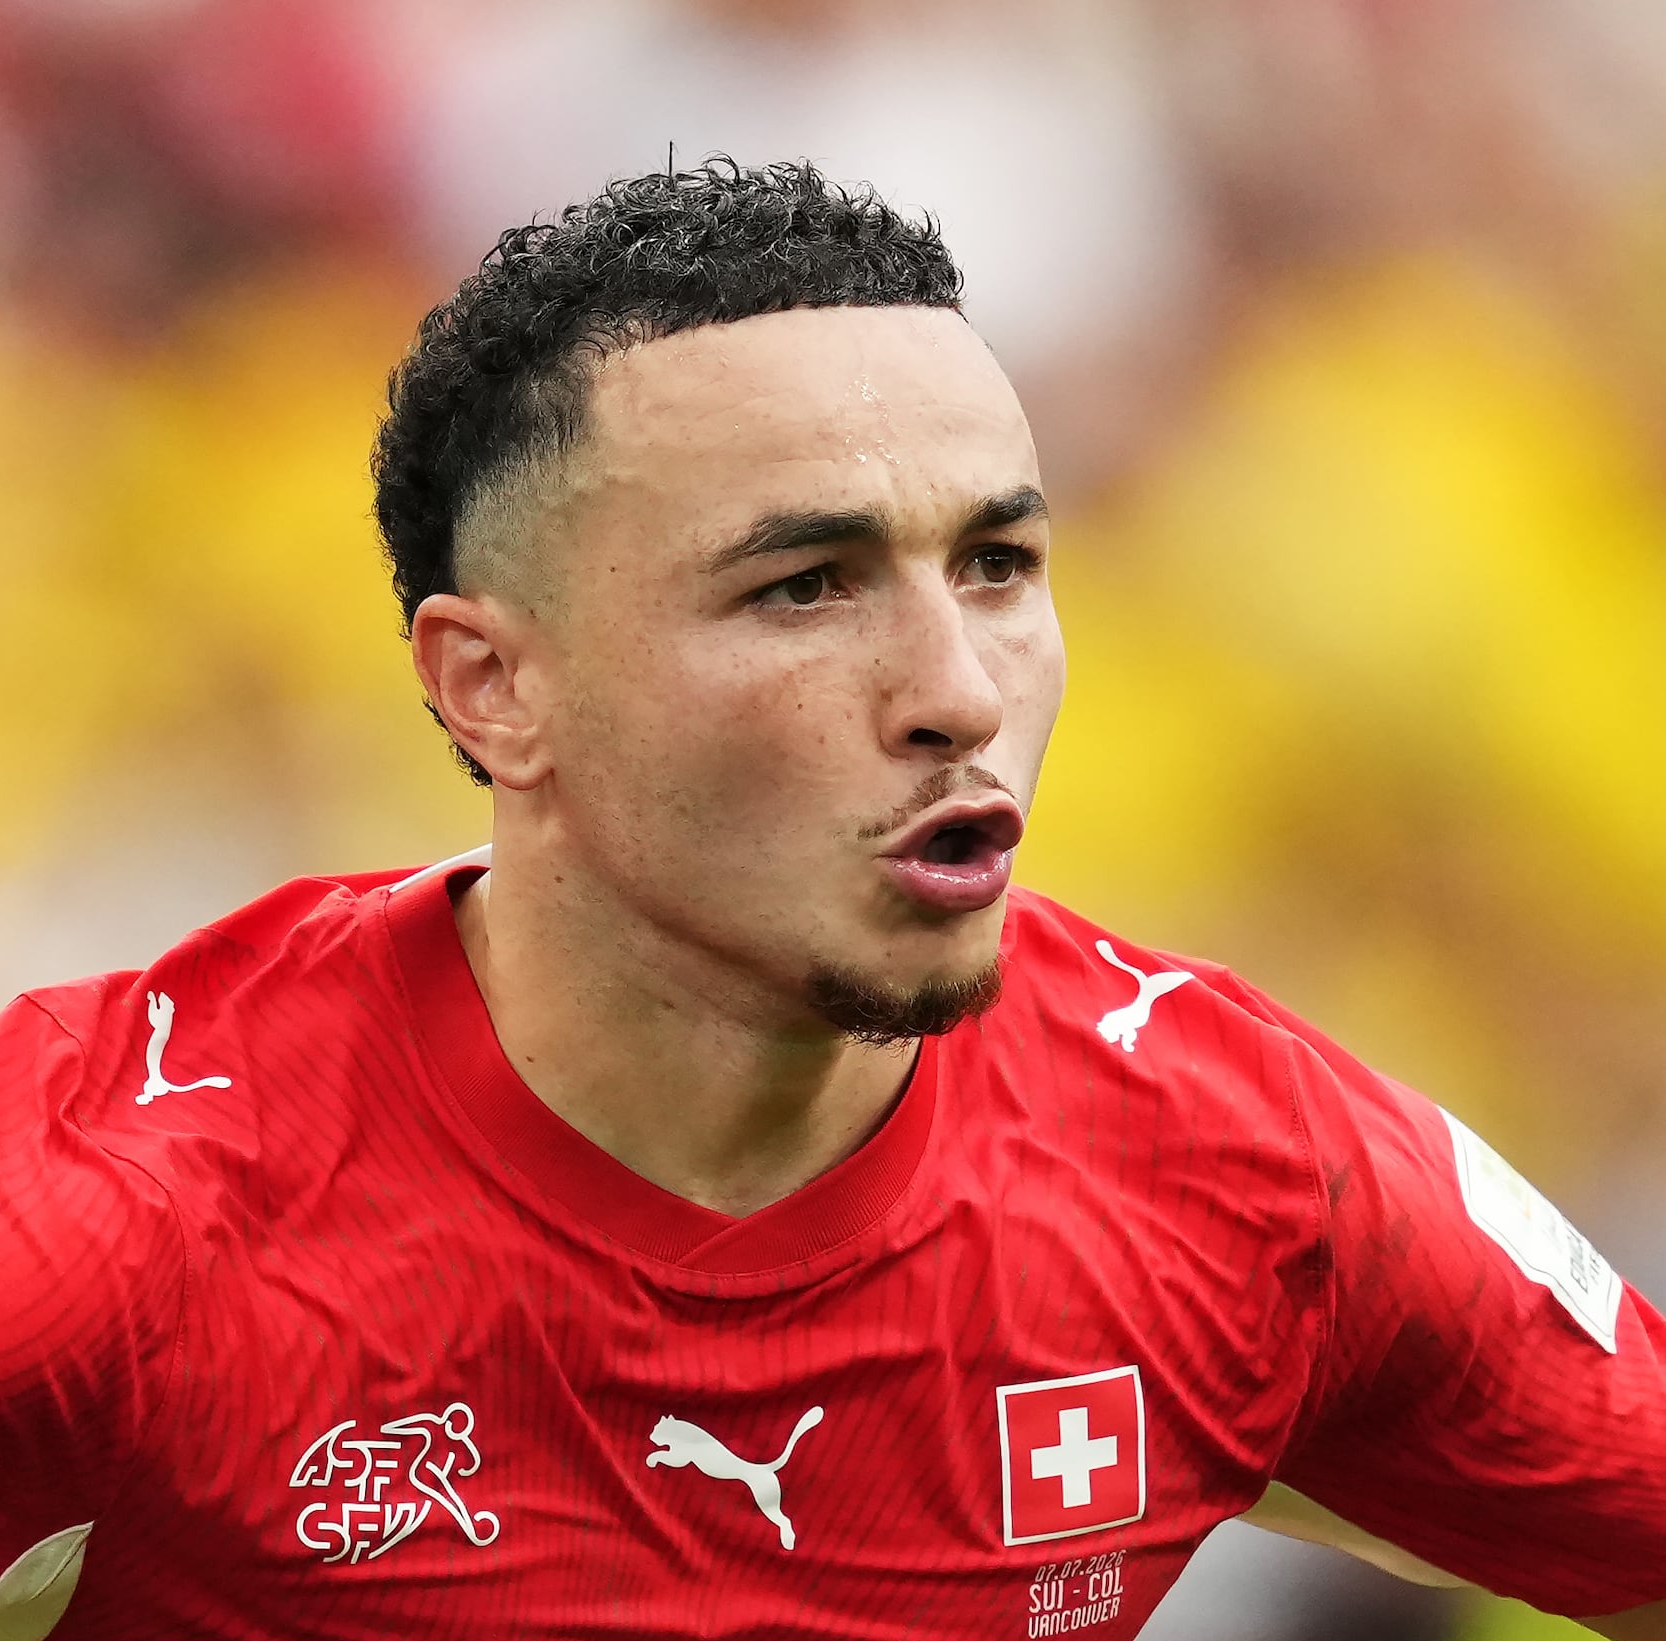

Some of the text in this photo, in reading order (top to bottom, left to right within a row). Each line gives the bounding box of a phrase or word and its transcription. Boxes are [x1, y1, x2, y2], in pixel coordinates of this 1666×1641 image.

[1035, 1549, 1127, 1582] 07.07.2026
[1028, 1580, 1064, 1614] SUI
[1088, 1566, 1124, 1602] COL
[1028, 1596, 1121, 1640] VANCOUVER
